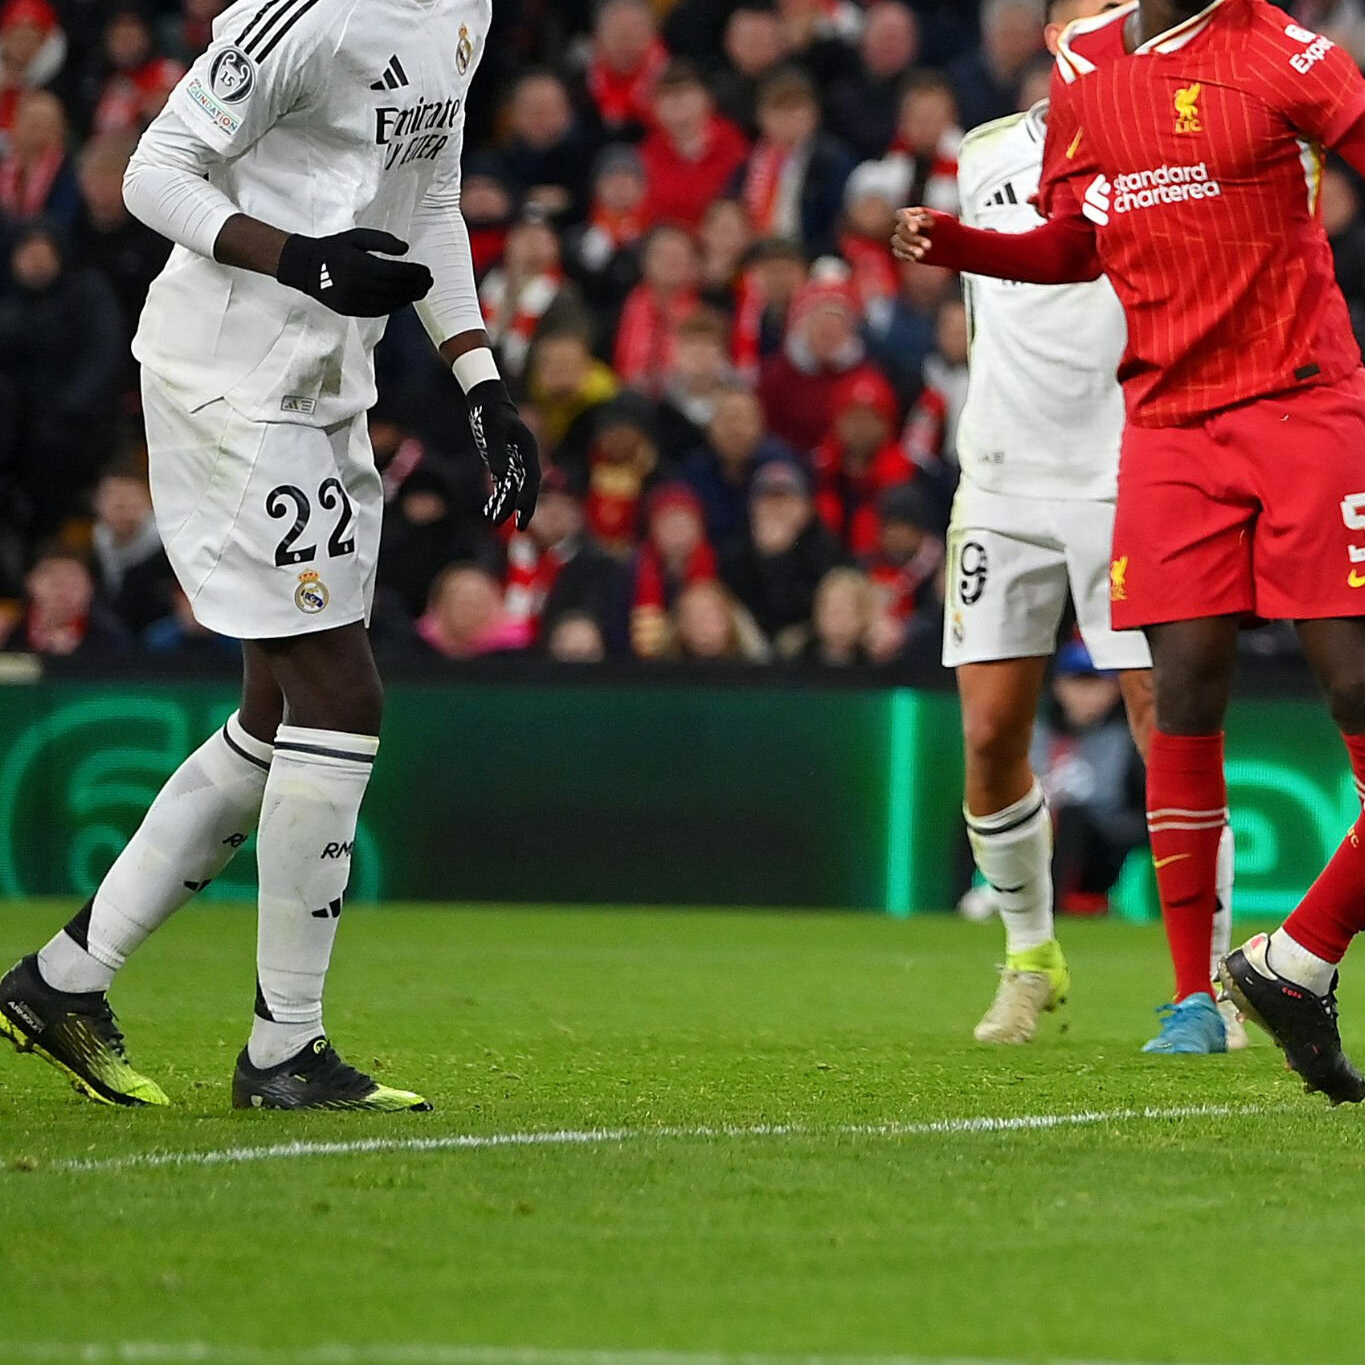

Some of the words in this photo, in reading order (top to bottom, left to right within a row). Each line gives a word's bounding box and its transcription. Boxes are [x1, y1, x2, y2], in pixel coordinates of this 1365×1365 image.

[220, 70, 236, 88] 15
[1113, 162, 1208, 196] standard
[1113, 181, 1221, 214] chartered
[266, 478, 356, 567] 22
